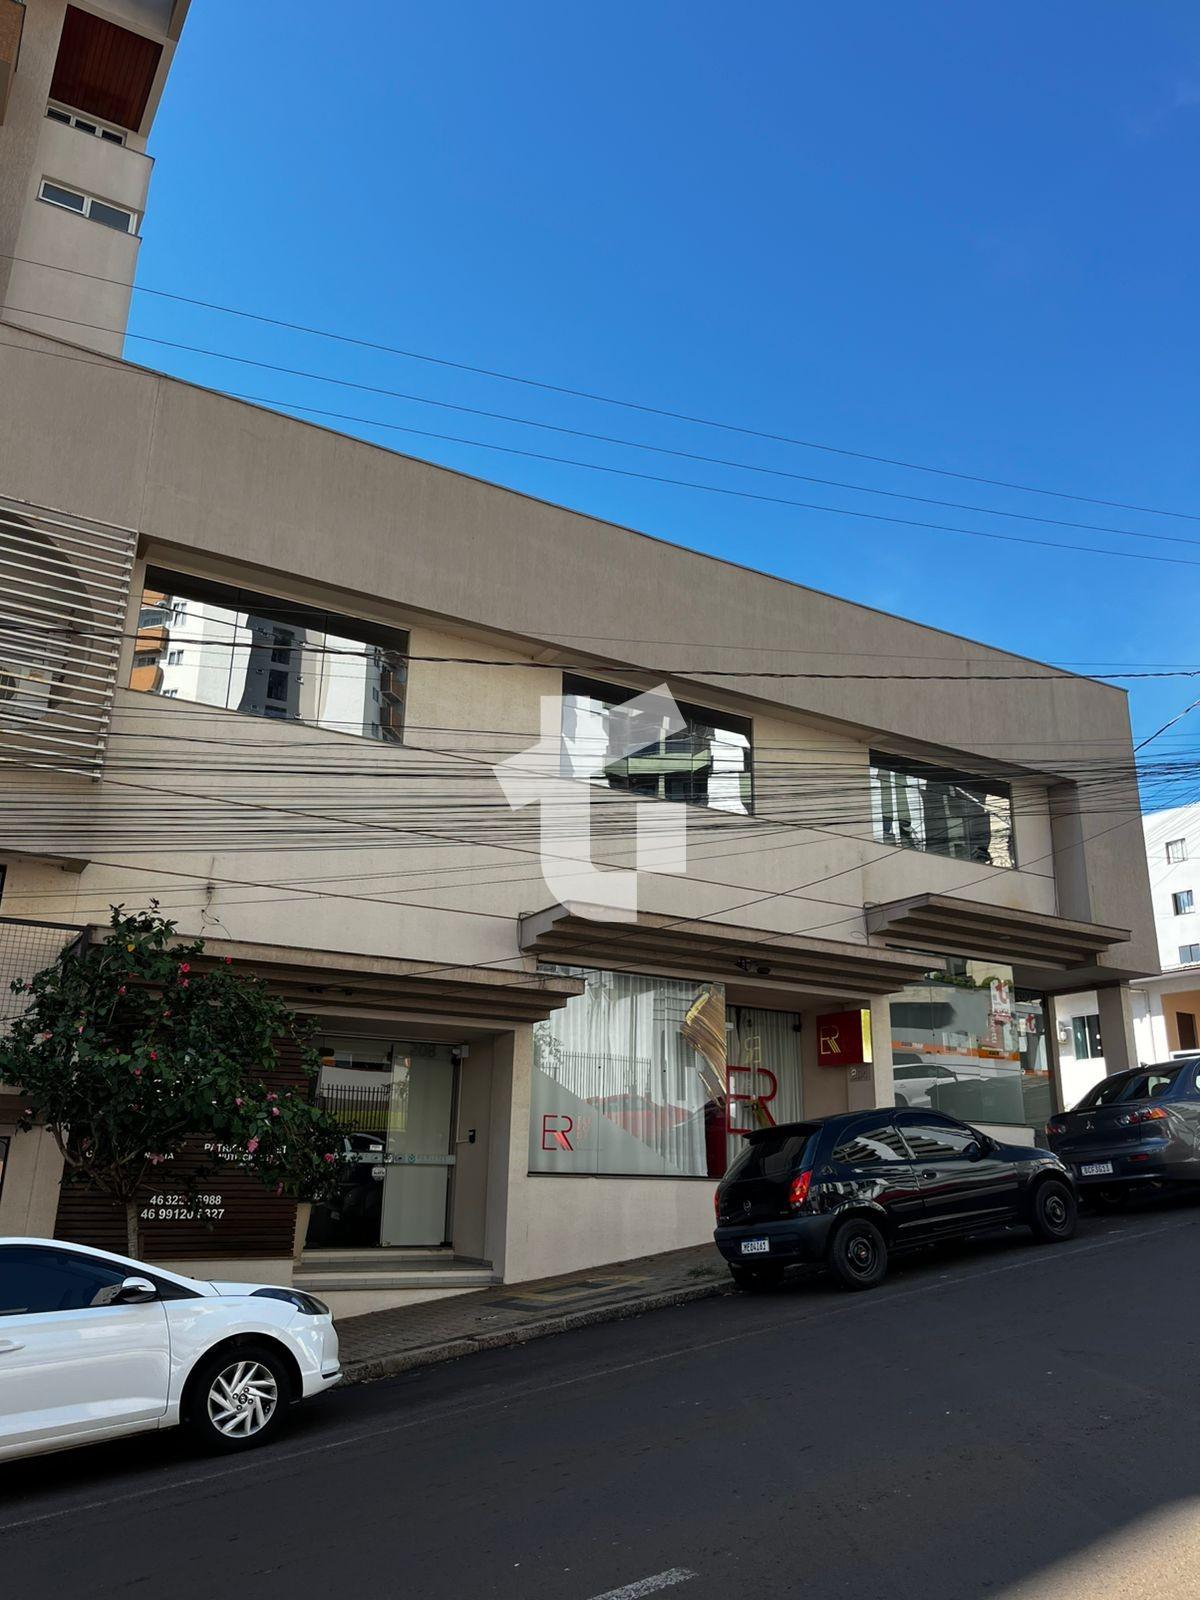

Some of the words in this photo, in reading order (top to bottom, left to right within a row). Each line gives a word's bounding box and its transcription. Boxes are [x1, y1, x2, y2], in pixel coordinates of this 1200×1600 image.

[820, 1025, 841, 1055] ER
[542, 1114, 574, 1152] ER
[149, 1194, 164, 1206] 46
[140, 1208, 156, 1220] 46
